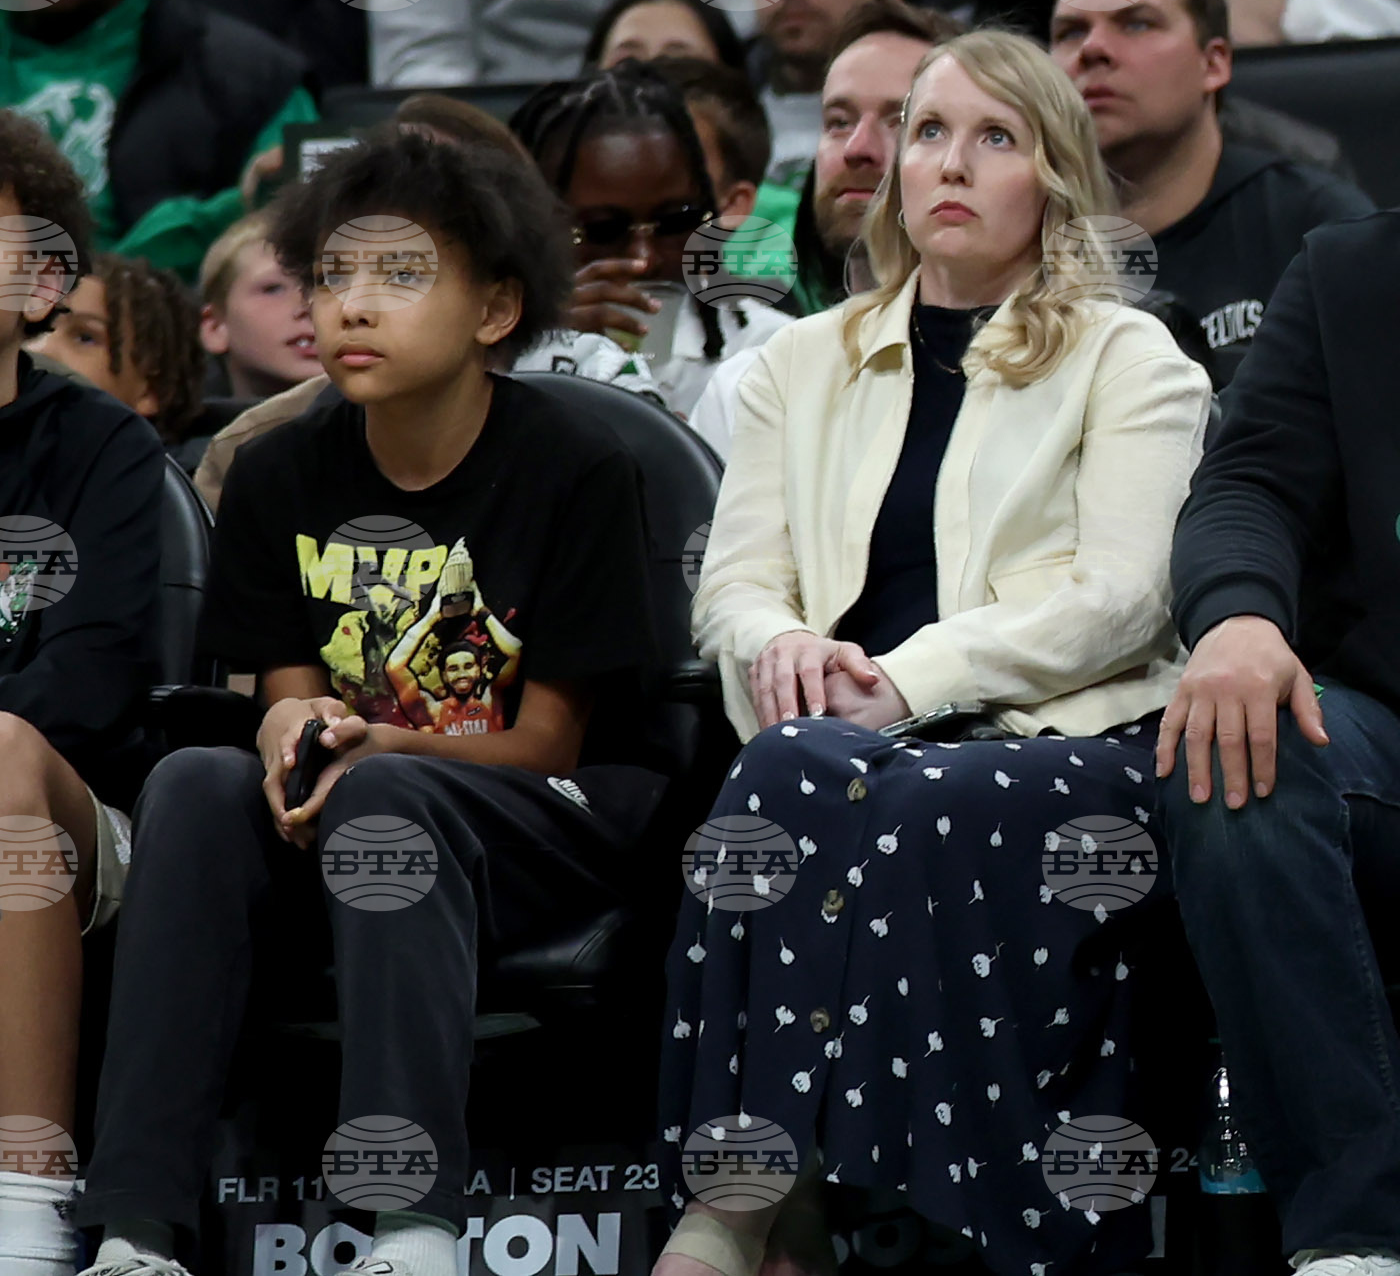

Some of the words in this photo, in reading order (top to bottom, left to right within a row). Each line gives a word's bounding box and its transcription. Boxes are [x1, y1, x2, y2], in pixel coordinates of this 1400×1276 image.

[558, 779, 590, 805] NIKE
[218, 1176, 279, 1203] FLR
[531, 1165, 615, 1194] SEAT
[624, 1163, 659, 1191] 23
